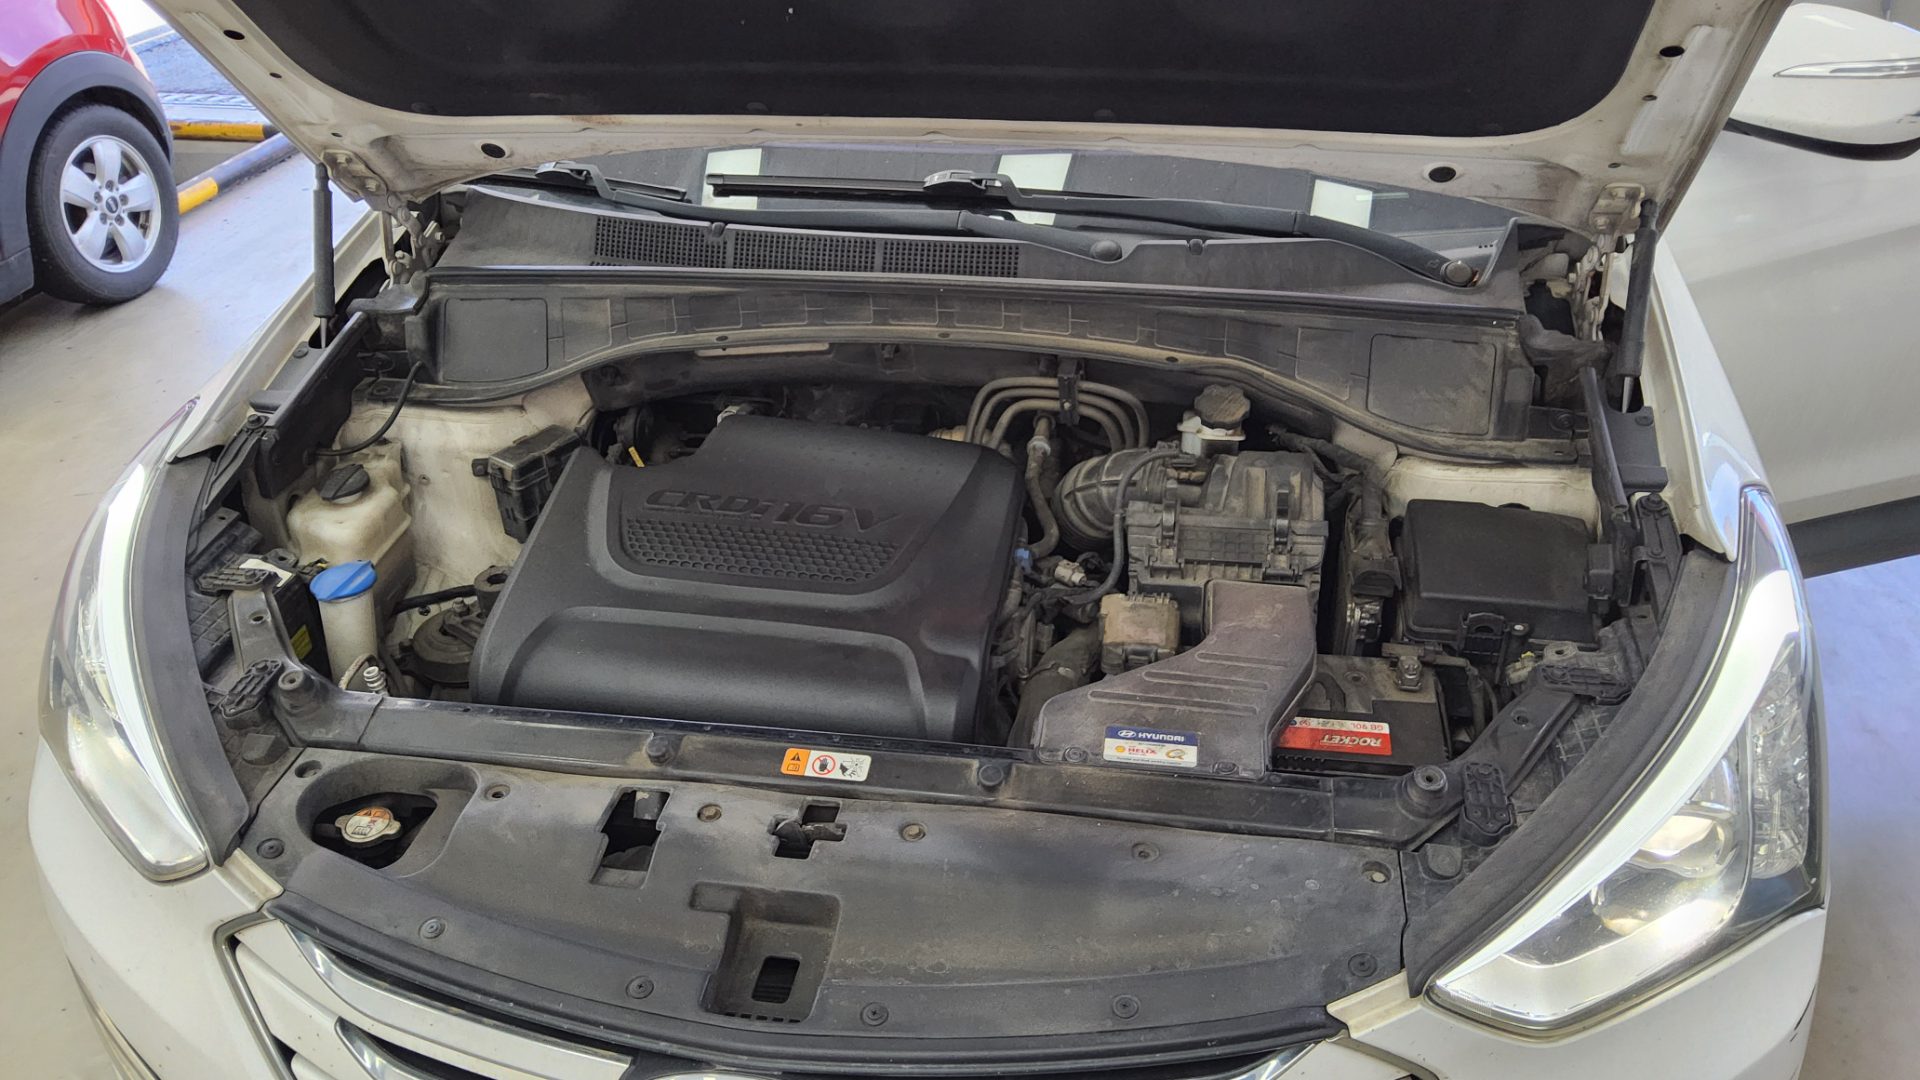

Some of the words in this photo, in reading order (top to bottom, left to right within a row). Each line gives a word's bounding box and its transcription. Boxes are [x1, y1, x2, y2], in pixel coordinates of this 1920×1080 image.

[1138, 731, 1185, 742] HYUNDAI
[1320, 734, 1383, 747] ROCKET
[1128, 746, 1158, 755] HELIX
